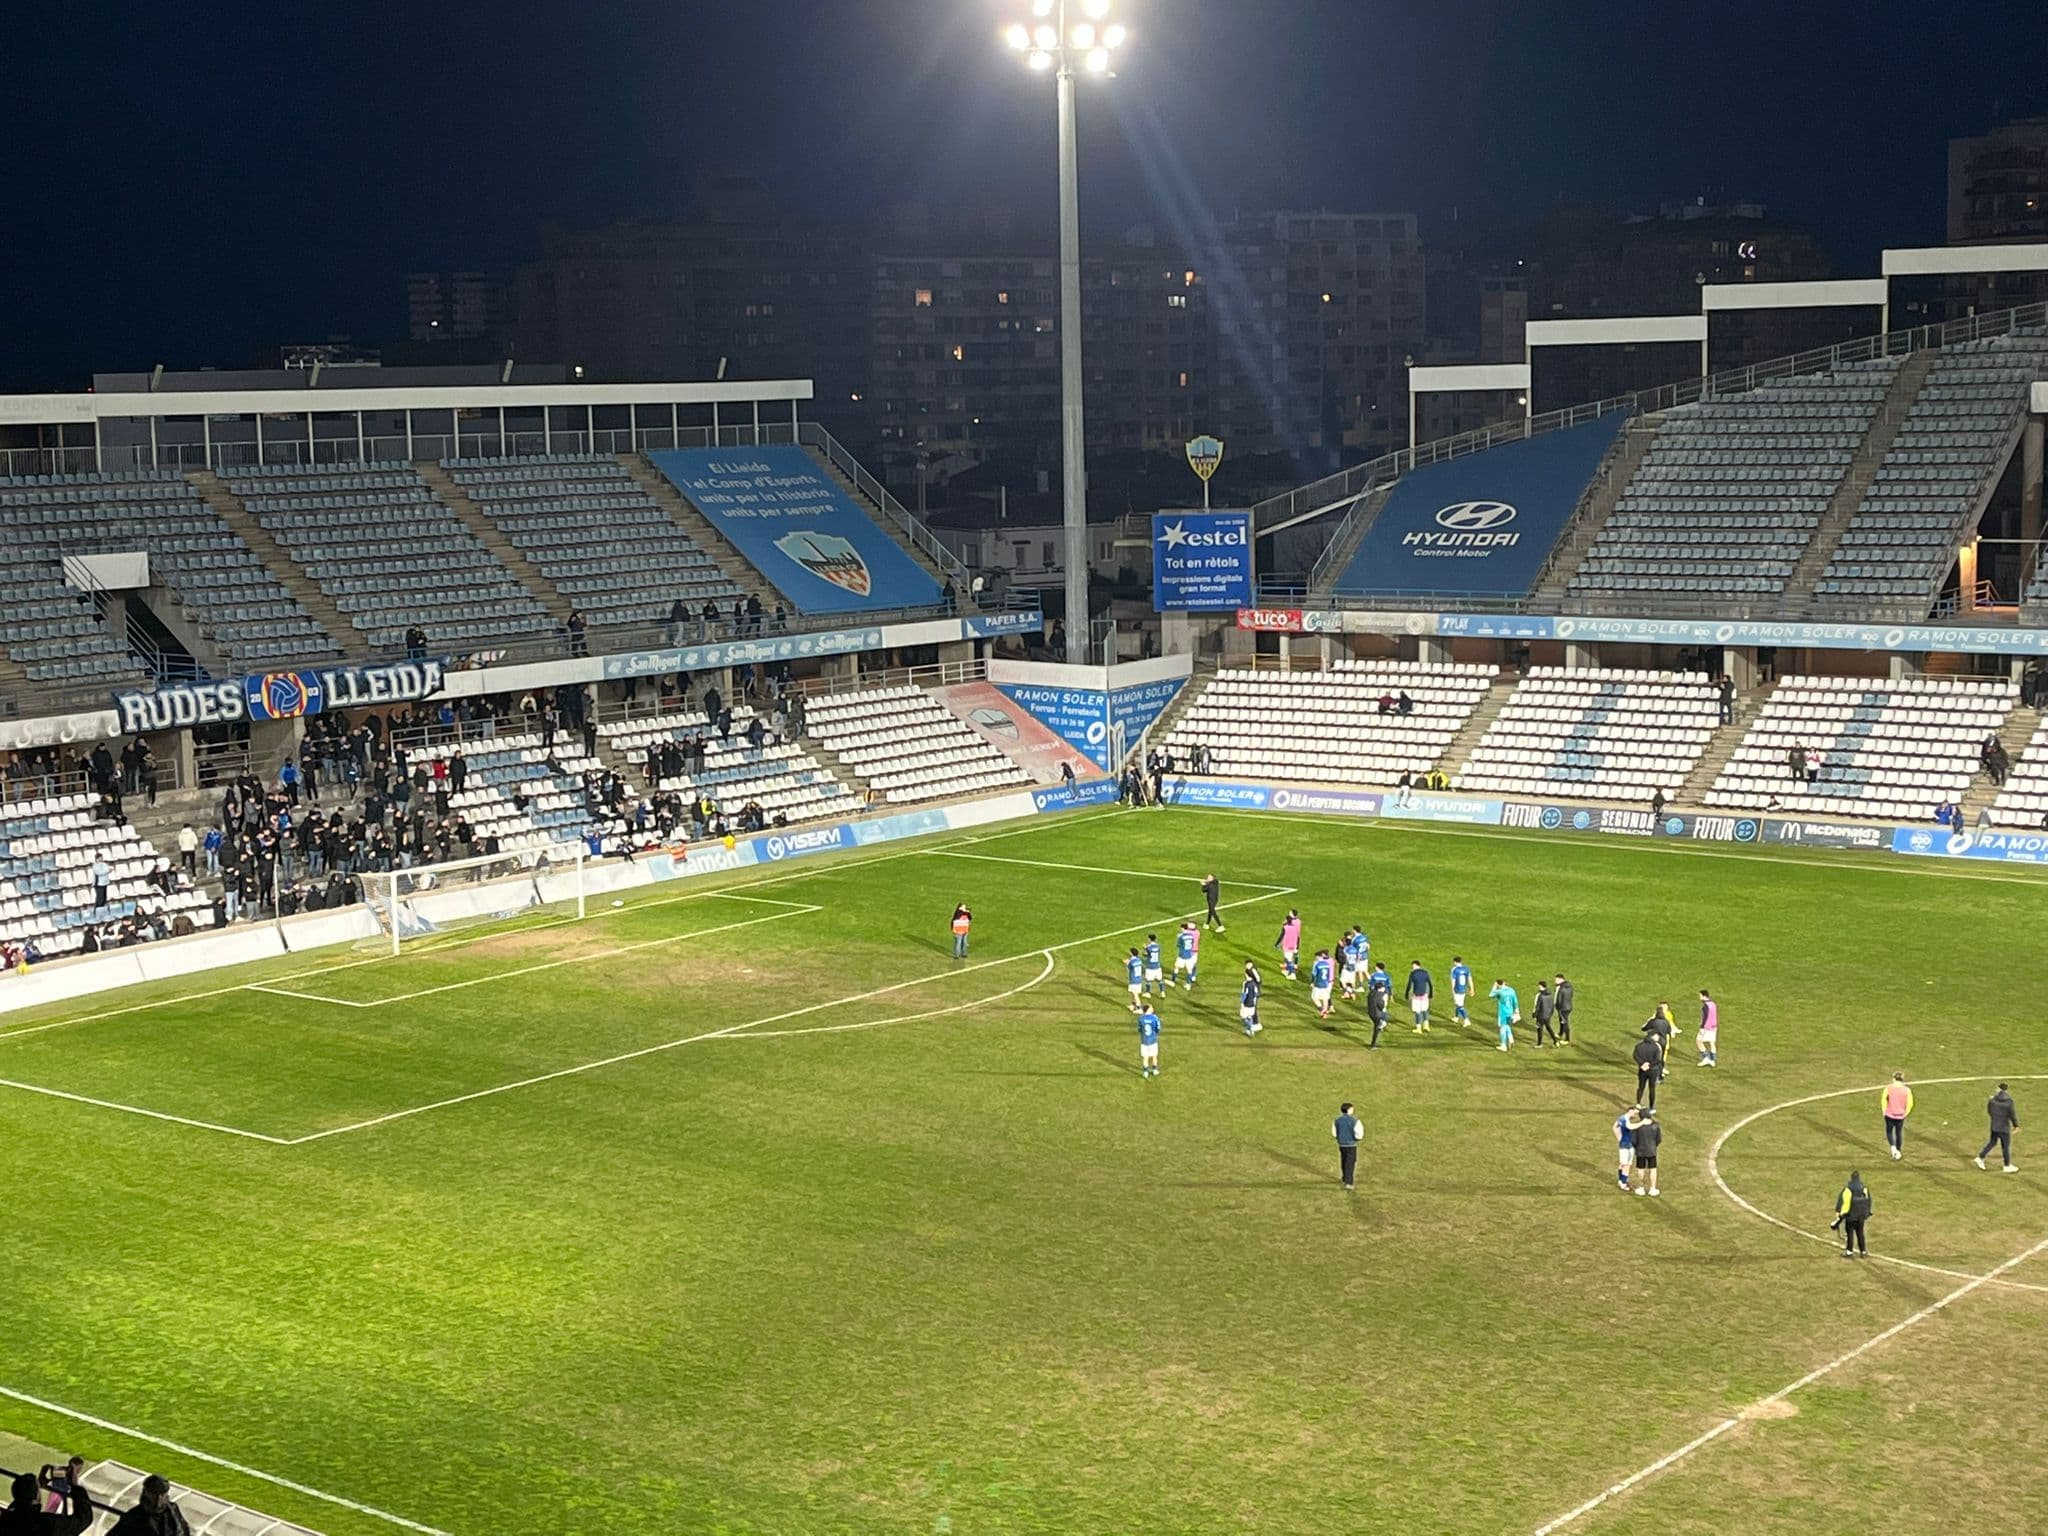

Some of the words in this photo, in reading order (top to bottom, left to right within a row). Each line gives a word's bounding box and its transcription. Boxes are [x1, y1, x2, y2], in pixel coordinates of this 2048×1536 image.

[708, 463, 725, 474] El
[728, 462, 771, 474] Lleida
[709, 478, 753, 490] Camp
[699, 494, 735, 504] units
[736, 494, 760, 505] per
[722, 507, 757, 518] units
[758, 507, 782, 518] per
[1187, 526, 1247, 546] estel
[1402, 532, 1520, 546] HYUNDAI
[1414, 549, 1456, 557] Control
[1456, 549, 1492, 557] Motor
[1165, 558, 1184, 568] Tot
[1187, 560, 1202, 568] en
[1179, 586, 1199, 594] gran
[985, 615, 1016, 627] PAFER
[1578, 621, 1632, 633] RAMON
[1637, 622, 1690, 635] SOLER
[1737, 625, 1796, 638] RAMON
[1801, 626, 1857, 639] SOLER
[1907, 630, 1970, 642] RAMON
[1976, 632, 2035, 644] SOLER
[119, 683, 243, 734] RUDES
[322, 662, 441, 709] LLEIDA
[1015, 689, 1059, 702] RAMON
[1062, 692, 1104, 706] SOLER
[1112, 690, 1143, 705] RAMON
[1145, 684, 1174, 699] SOLER
[1047, 791, 1074, 802] RAMO
[1080, 785, 1107, 796] SOLER
[1216, 789, 1254, 799] SOLER
[1425, 800, 1486, 813] HYUNDAI
[1601, 810, 1656, 829] SEGUNDA
[1804, 824, 1880, 839] McDonald's
[783, 828, 841, 851] VISERVI
